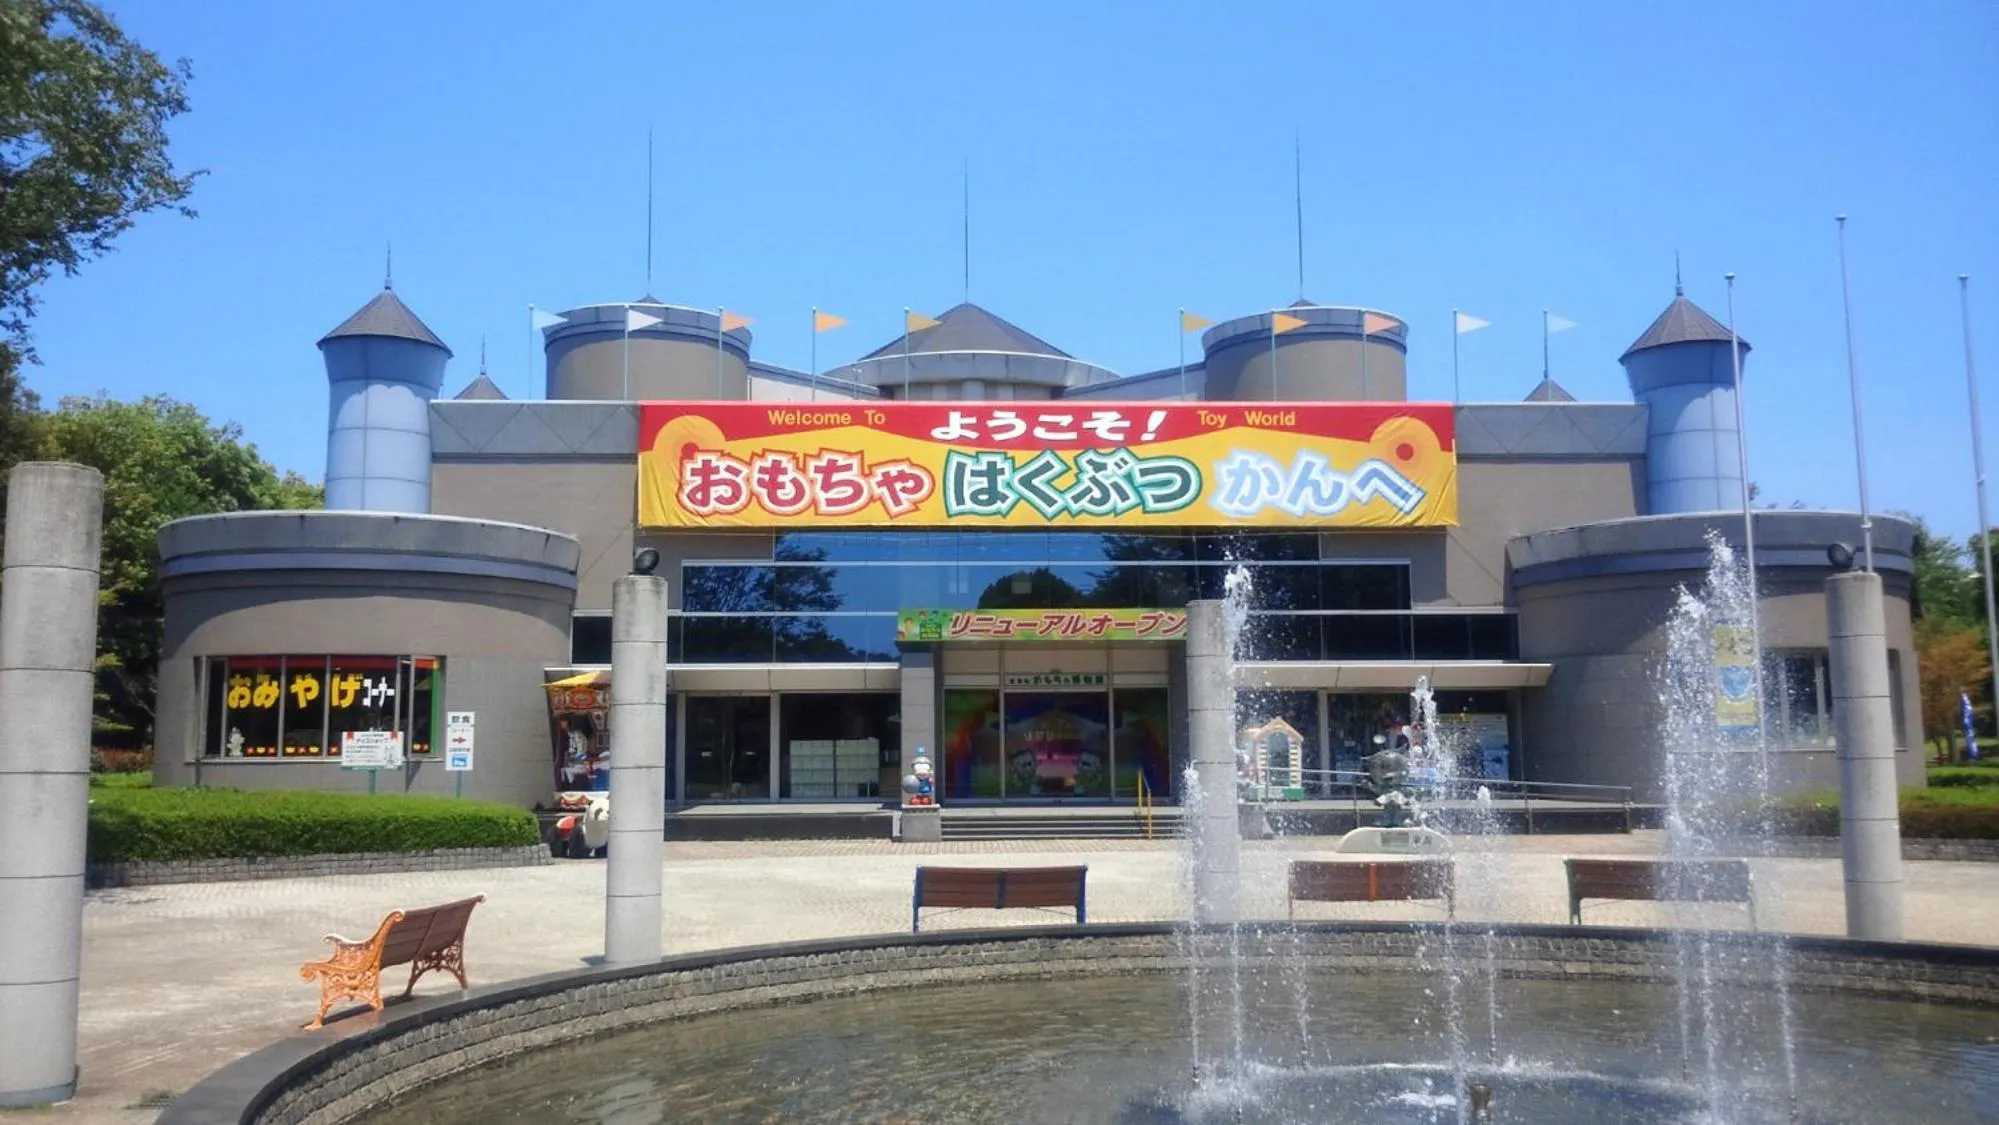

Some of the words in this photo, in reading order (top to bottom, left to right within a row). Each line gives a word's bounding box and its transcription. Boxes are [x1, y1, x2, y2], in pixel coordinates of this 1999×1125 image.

[768, 410, 852, 426] Welcome
[864, 410, 886, 426] To
[930, 410, 1168, 441] ようこそ！
[1197, 411, 1228, 428] Toy
[1244, 411, 1296, 427] World
[681, 453, 931, 514] おもちゃ
[948, 452, 1197, 515] はくぶつ
[1213, 453, 1424, 514] かんへ
